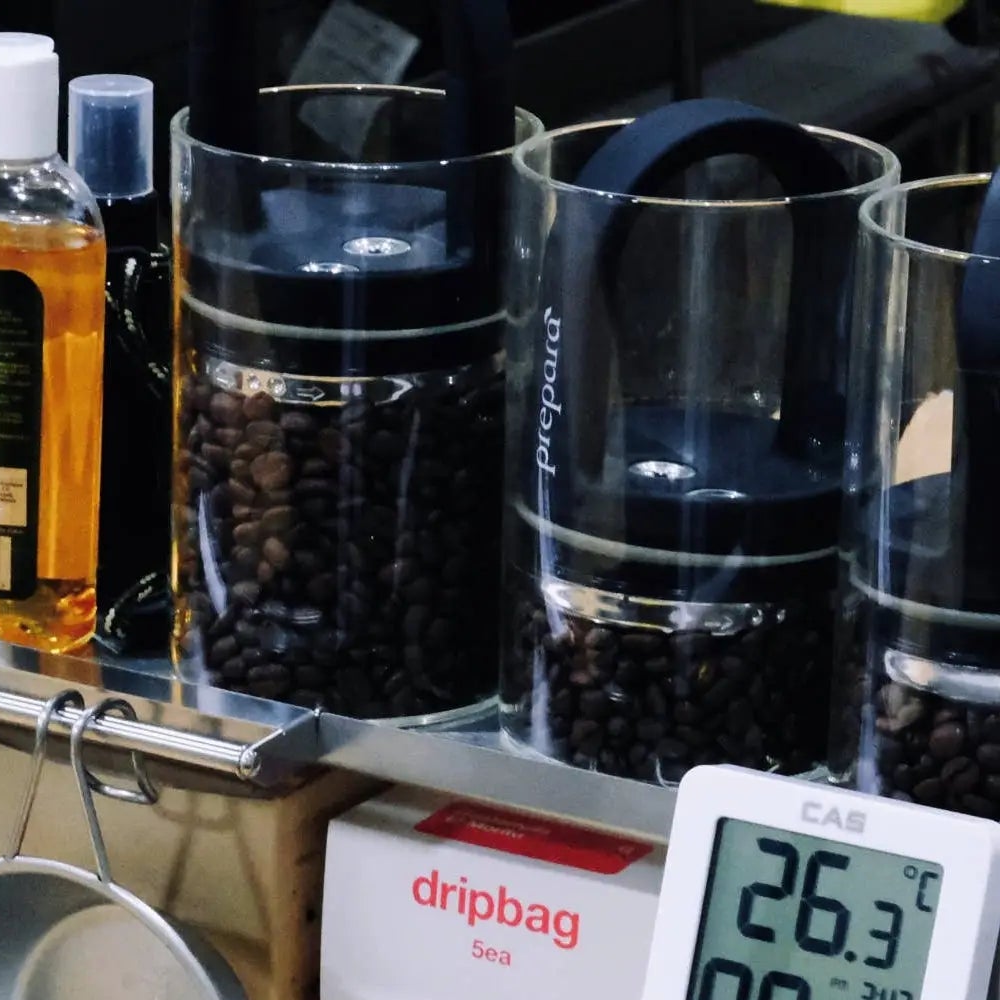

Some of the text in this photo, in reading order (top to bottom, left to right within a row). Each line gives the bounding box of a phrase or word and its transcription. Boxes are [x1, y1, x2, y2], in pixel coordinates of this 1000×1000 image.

[800, 801, 868, 833] CAS
[412, 869, 580, 950] dripbag
[737, 837, 904, 970] 26.3
[472, 939, 512, 967] 5ea
